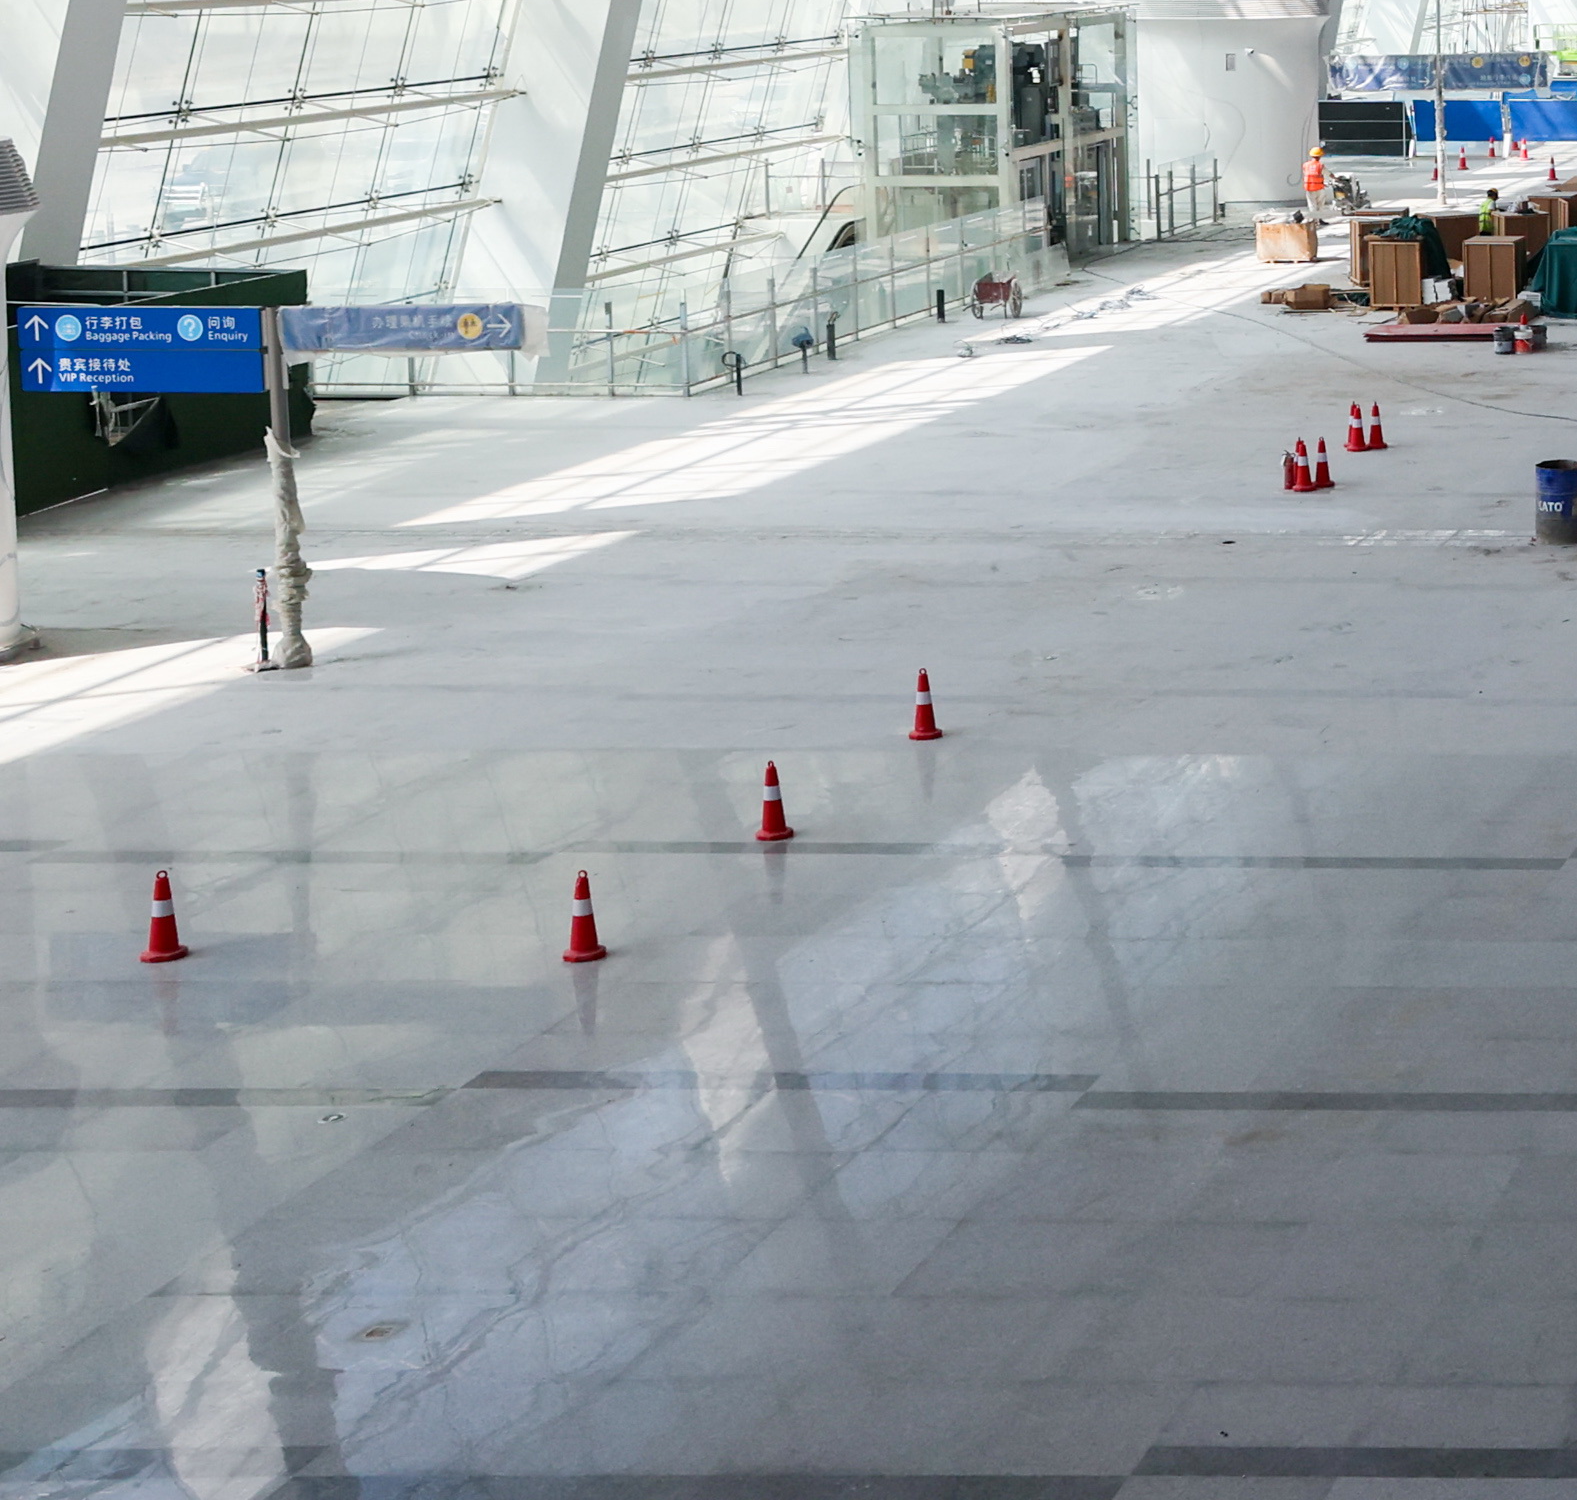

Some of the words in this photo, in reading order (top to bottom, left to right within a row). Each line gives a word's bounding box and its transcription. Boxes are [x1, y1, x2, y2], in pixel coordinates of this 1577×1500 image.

[85, 316, 143, 330] 行李打包
[207, 316, 236, 330] 问询
[85, 331, 131, 342] Baggage
[132, 331, 172, 343] Packing
[208, 331, 248, 343] Enquiry
[58, 358, 131, 372] 贵宾接待处
[59, 373, 77, 382] VIP
[79, 373, 134, 383] Reception
